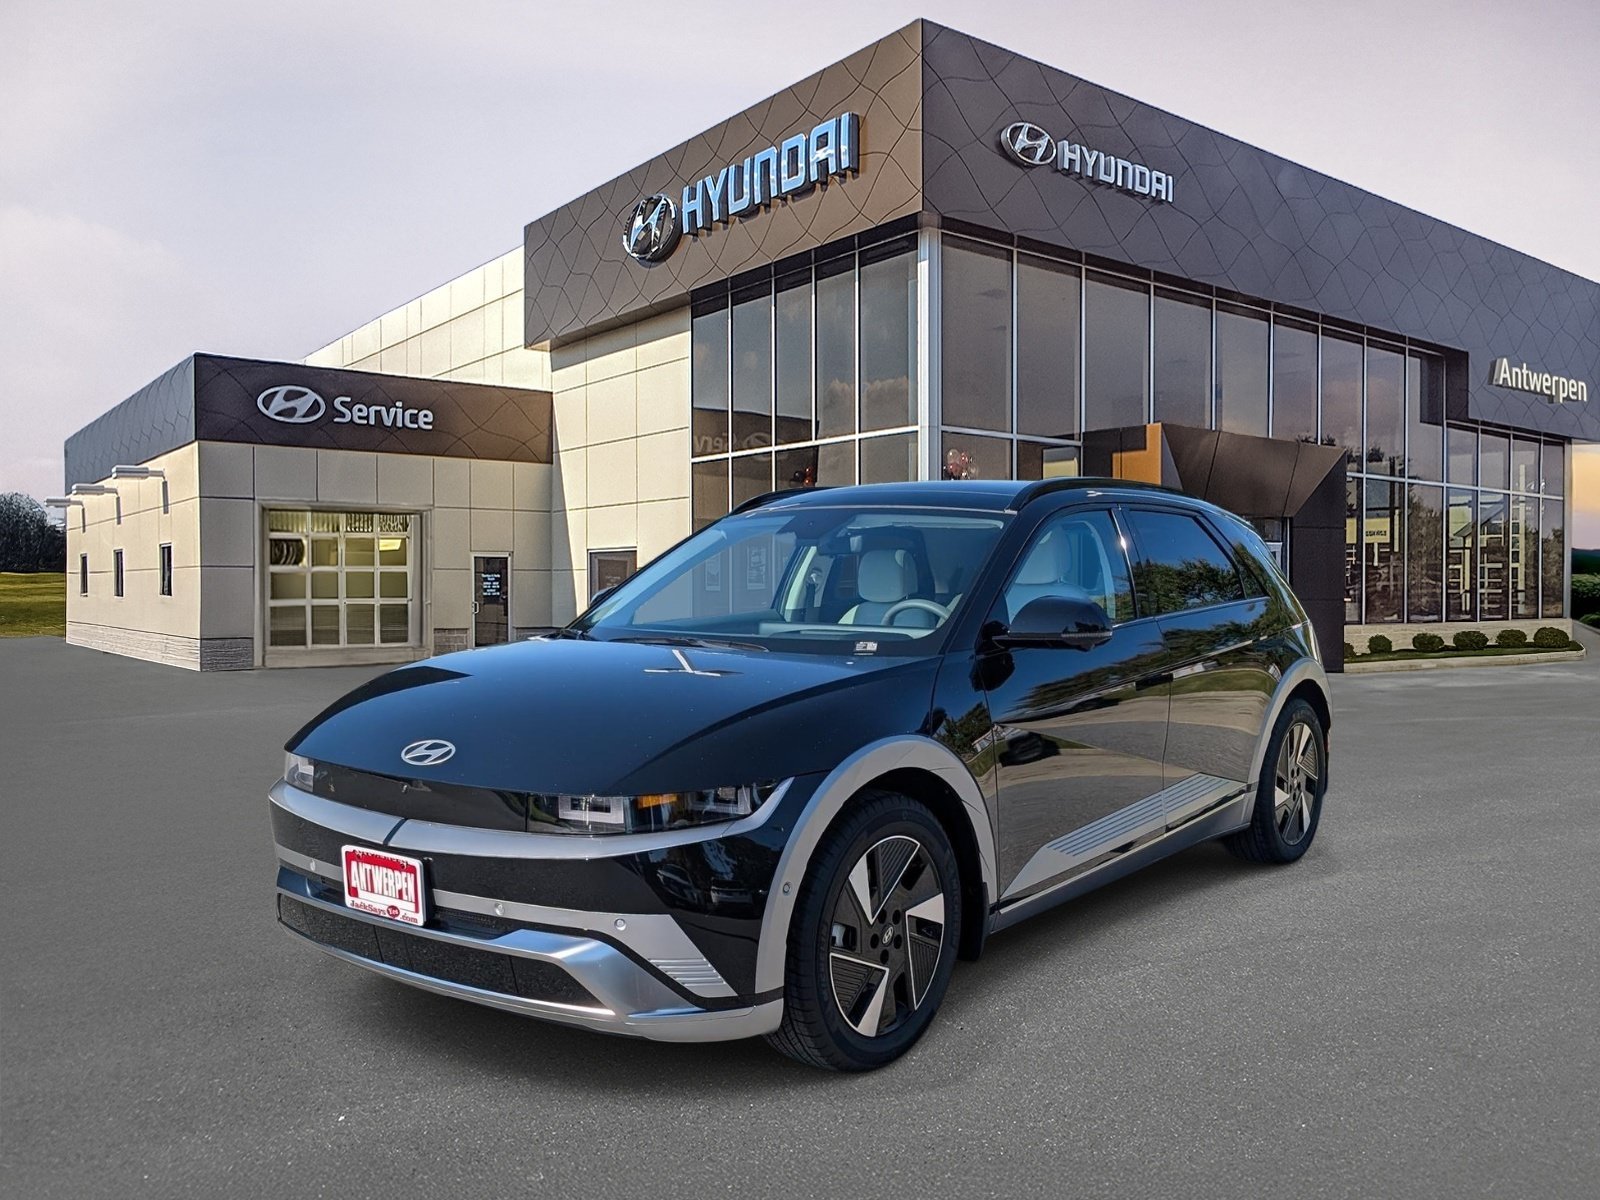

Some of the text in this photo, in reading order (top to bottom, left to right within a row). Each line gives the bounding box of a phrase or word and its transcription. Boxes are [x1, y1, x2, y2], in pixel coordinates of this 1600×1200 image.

[682, 112, 855, 235] HYUNDAI
[1057, 140, 1174, 203] HYUNDAI
[1494, 357, 1587, 404] Antwerpen
[333, 396, 434, 430] Service
[350, 860, 416, 903] ANTWERPEN
